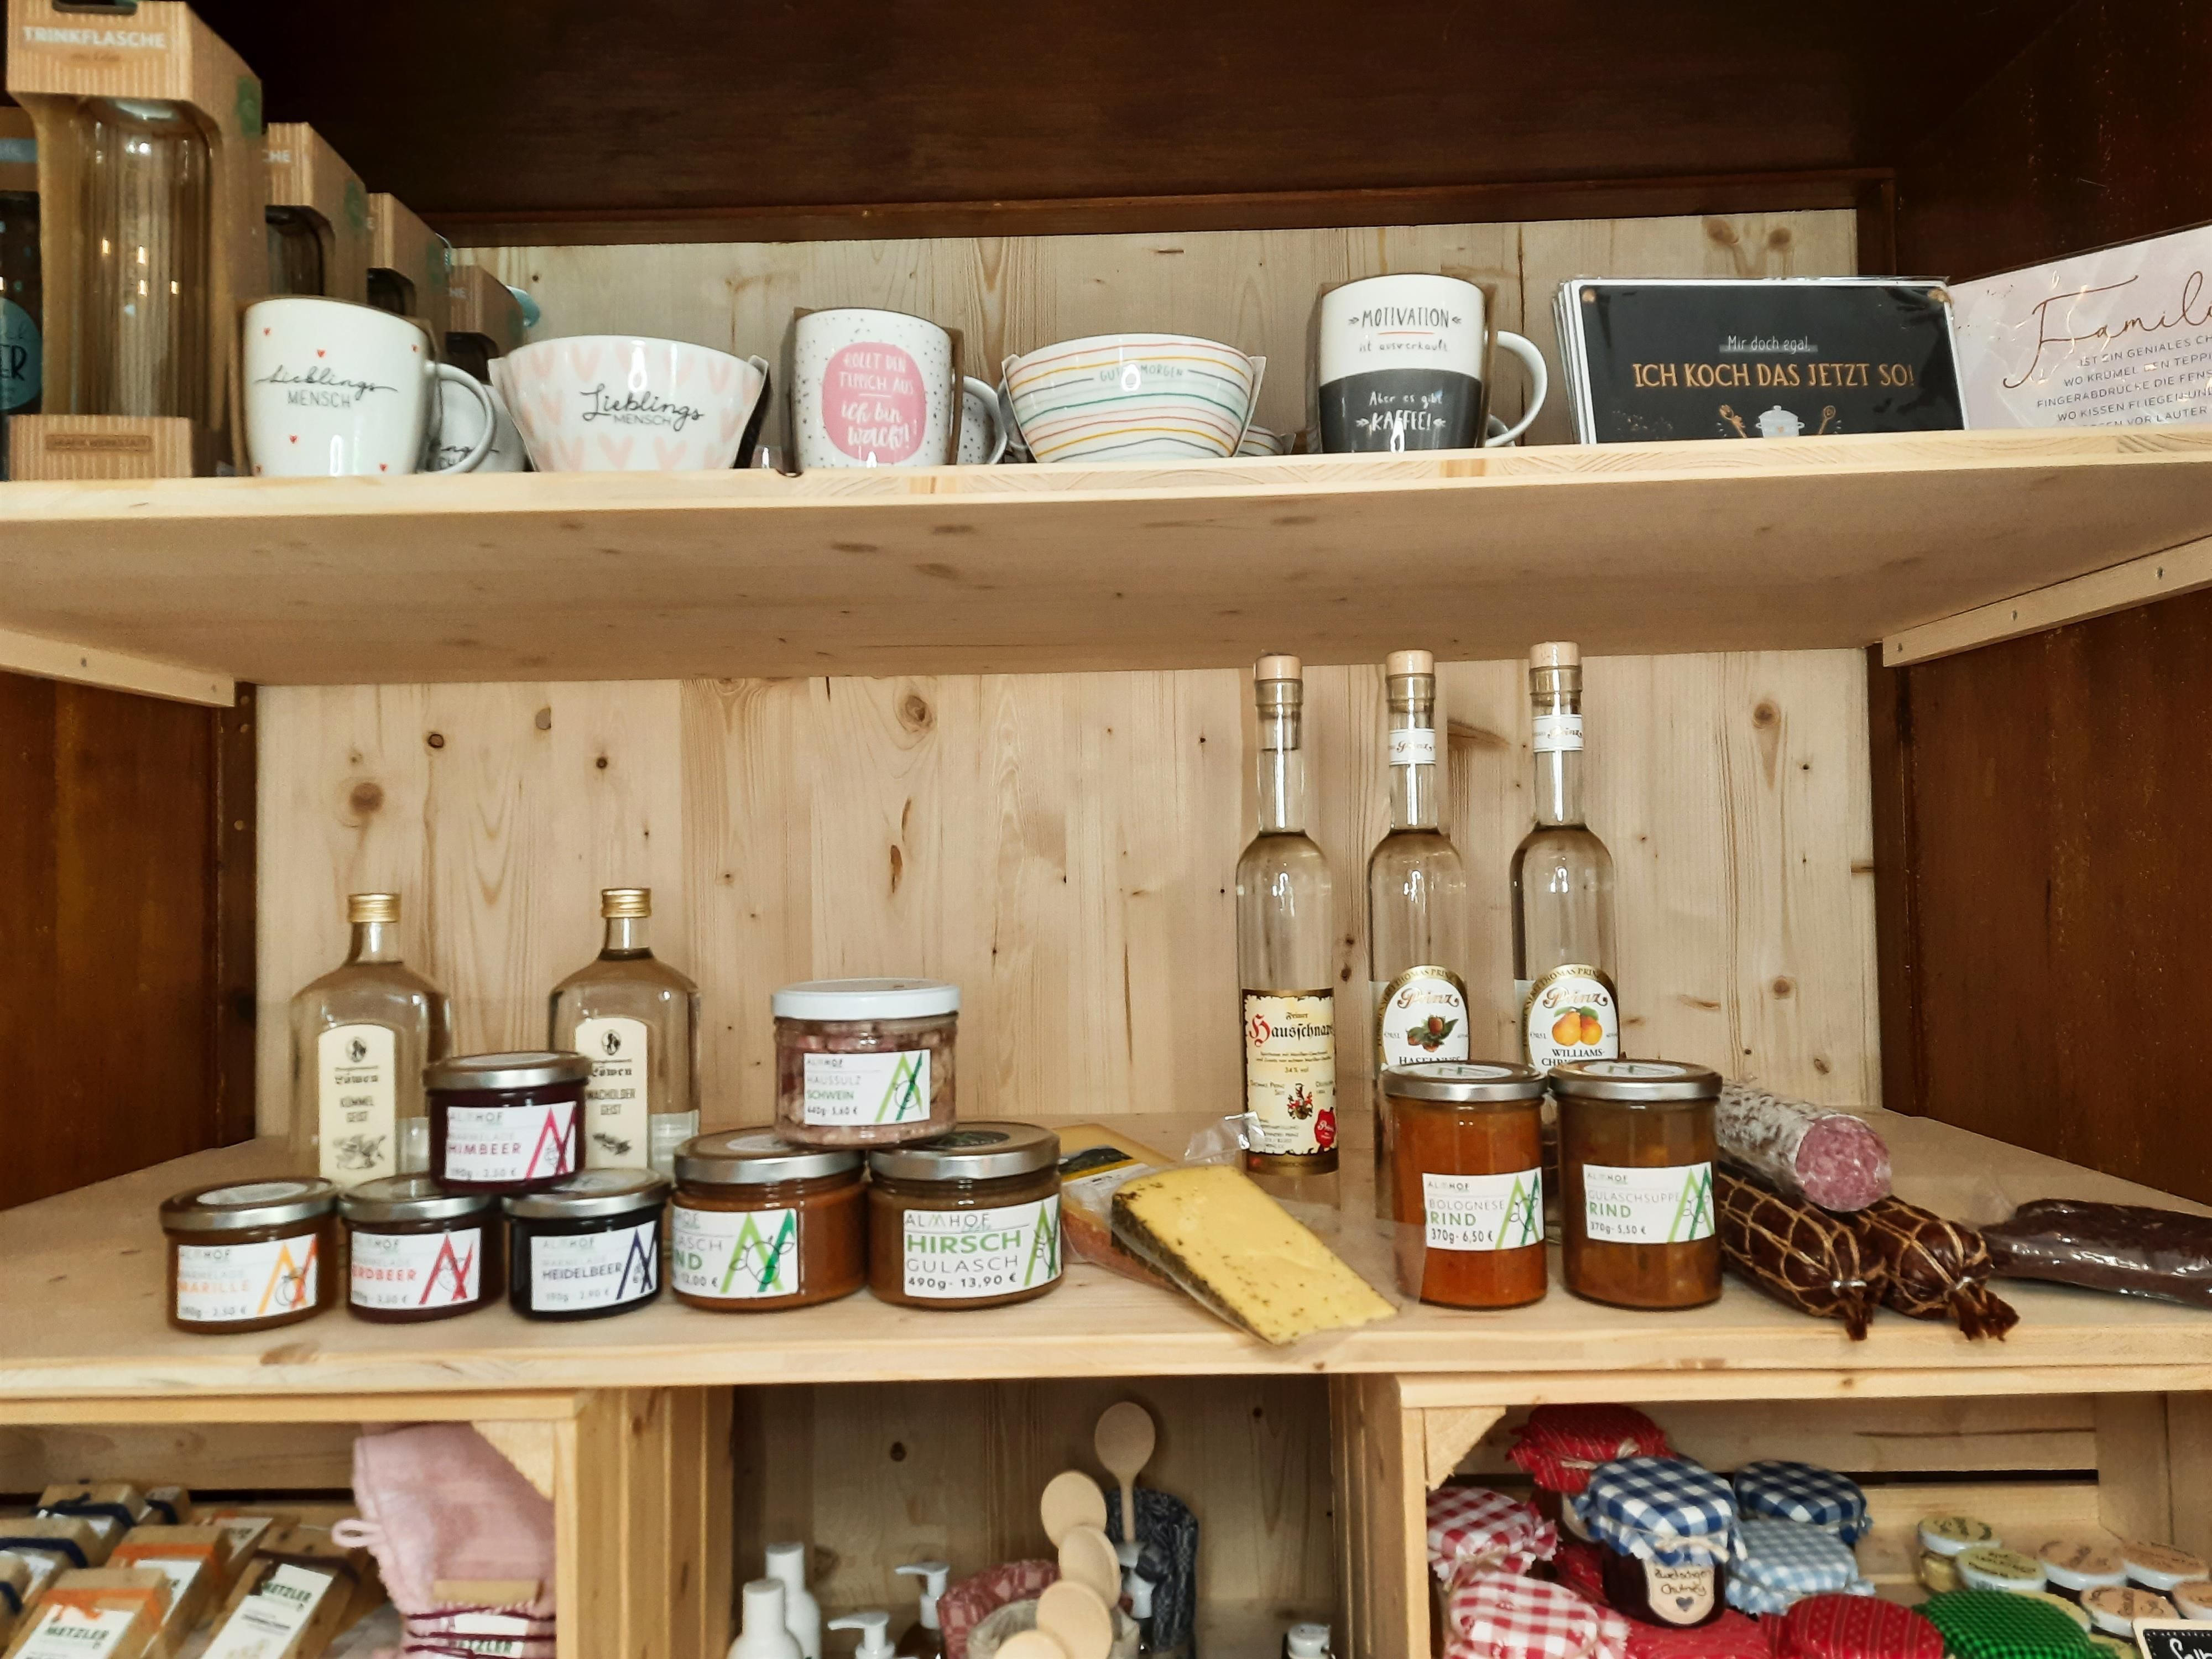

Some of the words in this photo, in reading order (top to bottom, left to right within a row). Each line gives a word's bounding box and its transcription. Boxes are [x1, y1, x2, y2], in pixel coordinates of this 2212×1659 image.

[23, 26, 165, 48] TRINKFLASCHE
[1361, 306, 1449, 328] MOTIVATION
[1359, 340, 1371, 352] ist
[1728, 335, 1747, 350] Mir
[1751, 335, 1779, 351] doch
[2127, 340, 2191, 358] GENIALES
[1140, 364, 1183, 378] MORGEN
[1632, 362, 1677, 387] ICH
[1684, 362, 1750, 388] KOCH
[1757, 362, 1801, 387] DAS
[1808, 362, 1870, 387] JETZT
[1879, 363, 1915, 387] SO!
[254, 364, 398, 401] Lieblings
[893, 377, 914, 394] AUS
[2064, 376, 2083, 387] WO
[2154, 376, 2174, 388] DIE
[288, 389, 351, 408] MENSCH
[1369, 390, 1396, 406] Aber
[1403, 394, 1415, 404] es
[1421, 391, 1443, 409] gibt
[580, 383, 705, 432] Lieblings
[841, 401, 869, 424] ich
[2057, 411, 2077, 422] WO
[2080, 401, 2125, 417] KISSEN
[2156, 406, 2208, 423] LAUTER
[614, 414, 672, 426] MENSCH
[1397, 987, 1459, 1009] Prinz
[1542, 987, 1608, 1009] Prinz
[807, 1089, 854, 1100] SCHWEIN
[448, 1142, 521, 1155] HIMBEER
[1429, 1198, 1504, 1211] BOLOGNESE
[1589, 1202, 1631, 1218] RIND
[905, 1212, 990, 1228] ALMHOF
[1430, 1211, 1477, 1227] RIND
[907, 1229, 1021, 1254] HIRSCH
[1463, 1230, 1484, 1244] 6,50
[542, 1262, 622, 1280] HEIDELBEER
[906, 1255, 1018, 1274] GULASCH
[961, 1275, 1003, 1288] 13,90
[1009, 1272, 1017, 1283] €
[46, 1626, 109, 1640] METZLER
